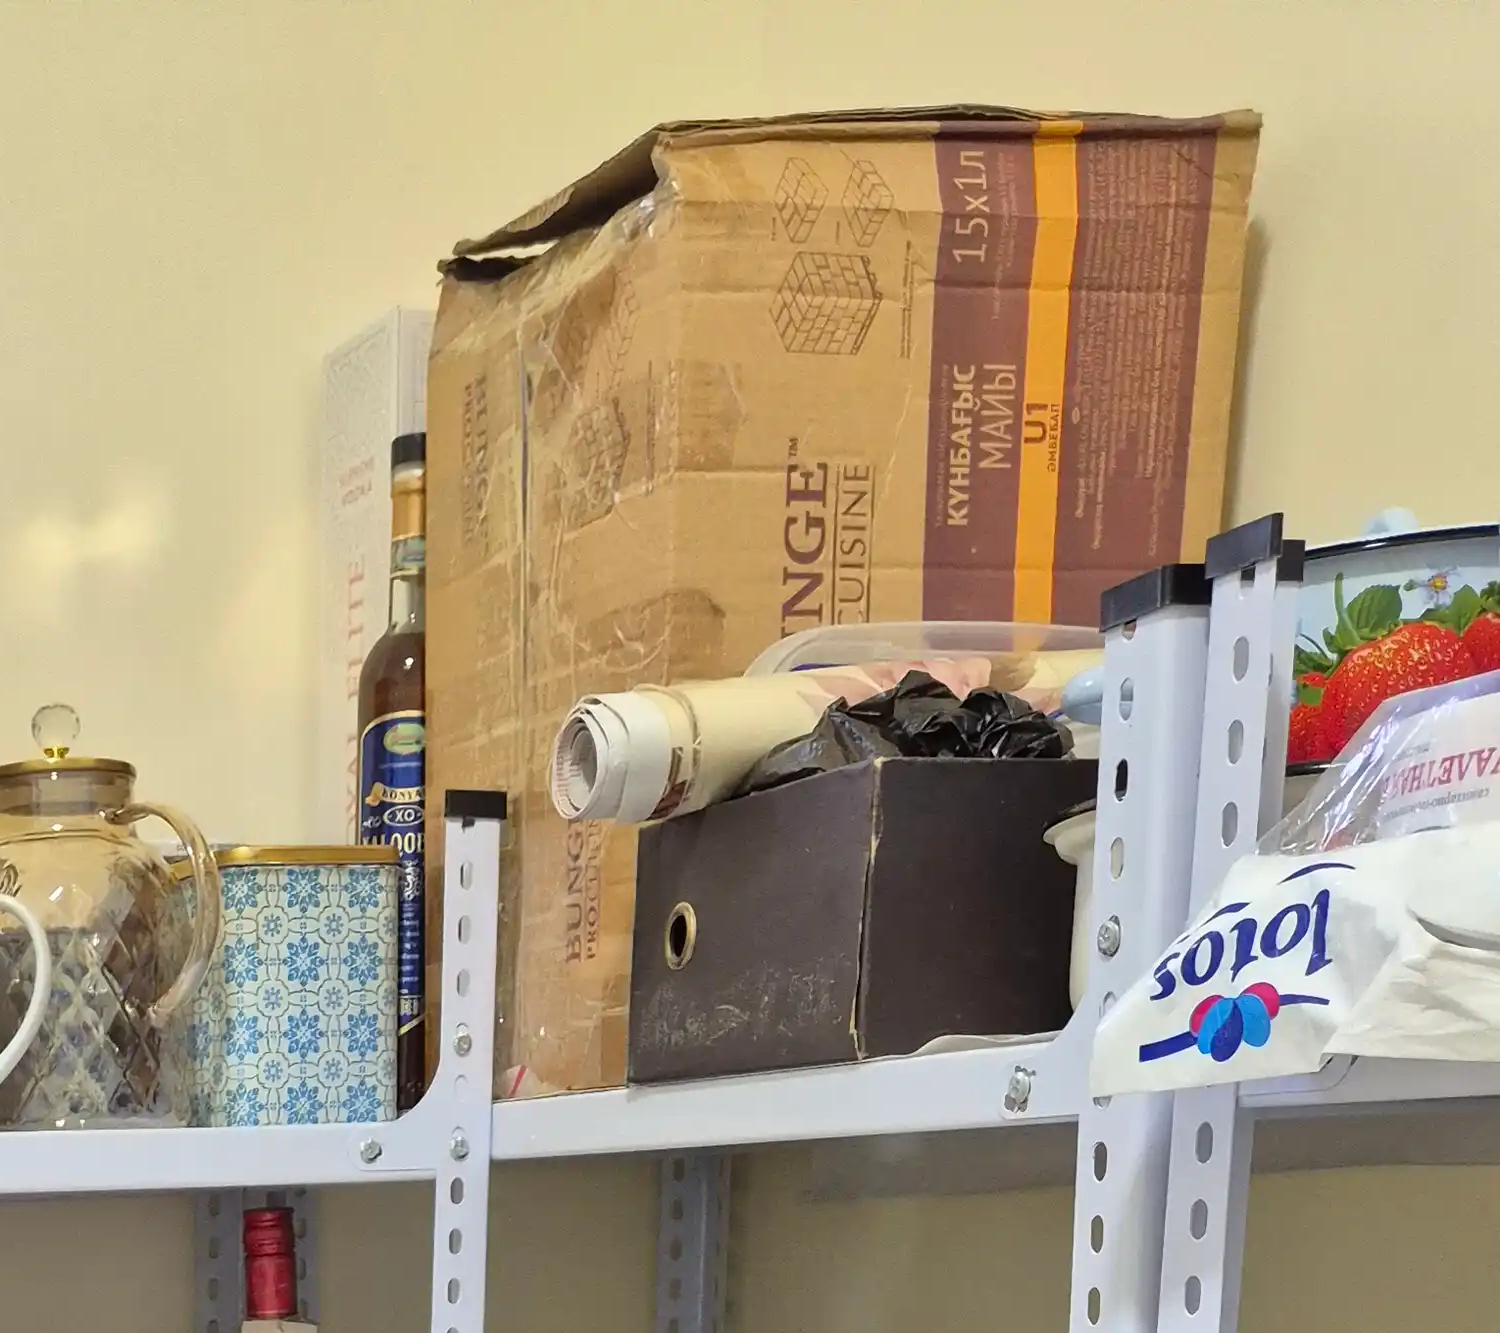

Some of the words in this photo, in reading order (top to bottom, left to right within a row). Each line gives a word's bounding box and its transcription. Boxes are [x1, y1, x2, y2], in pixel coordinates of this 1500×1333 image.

[974, 363, 1018, 470] МАЙЫ
[1023, 401, 1049, 446] U1
[781, 460, 829, 636] NGE
[394, 808, 417, 823] XO
[1148, 888, 1334, 1003] lotos
